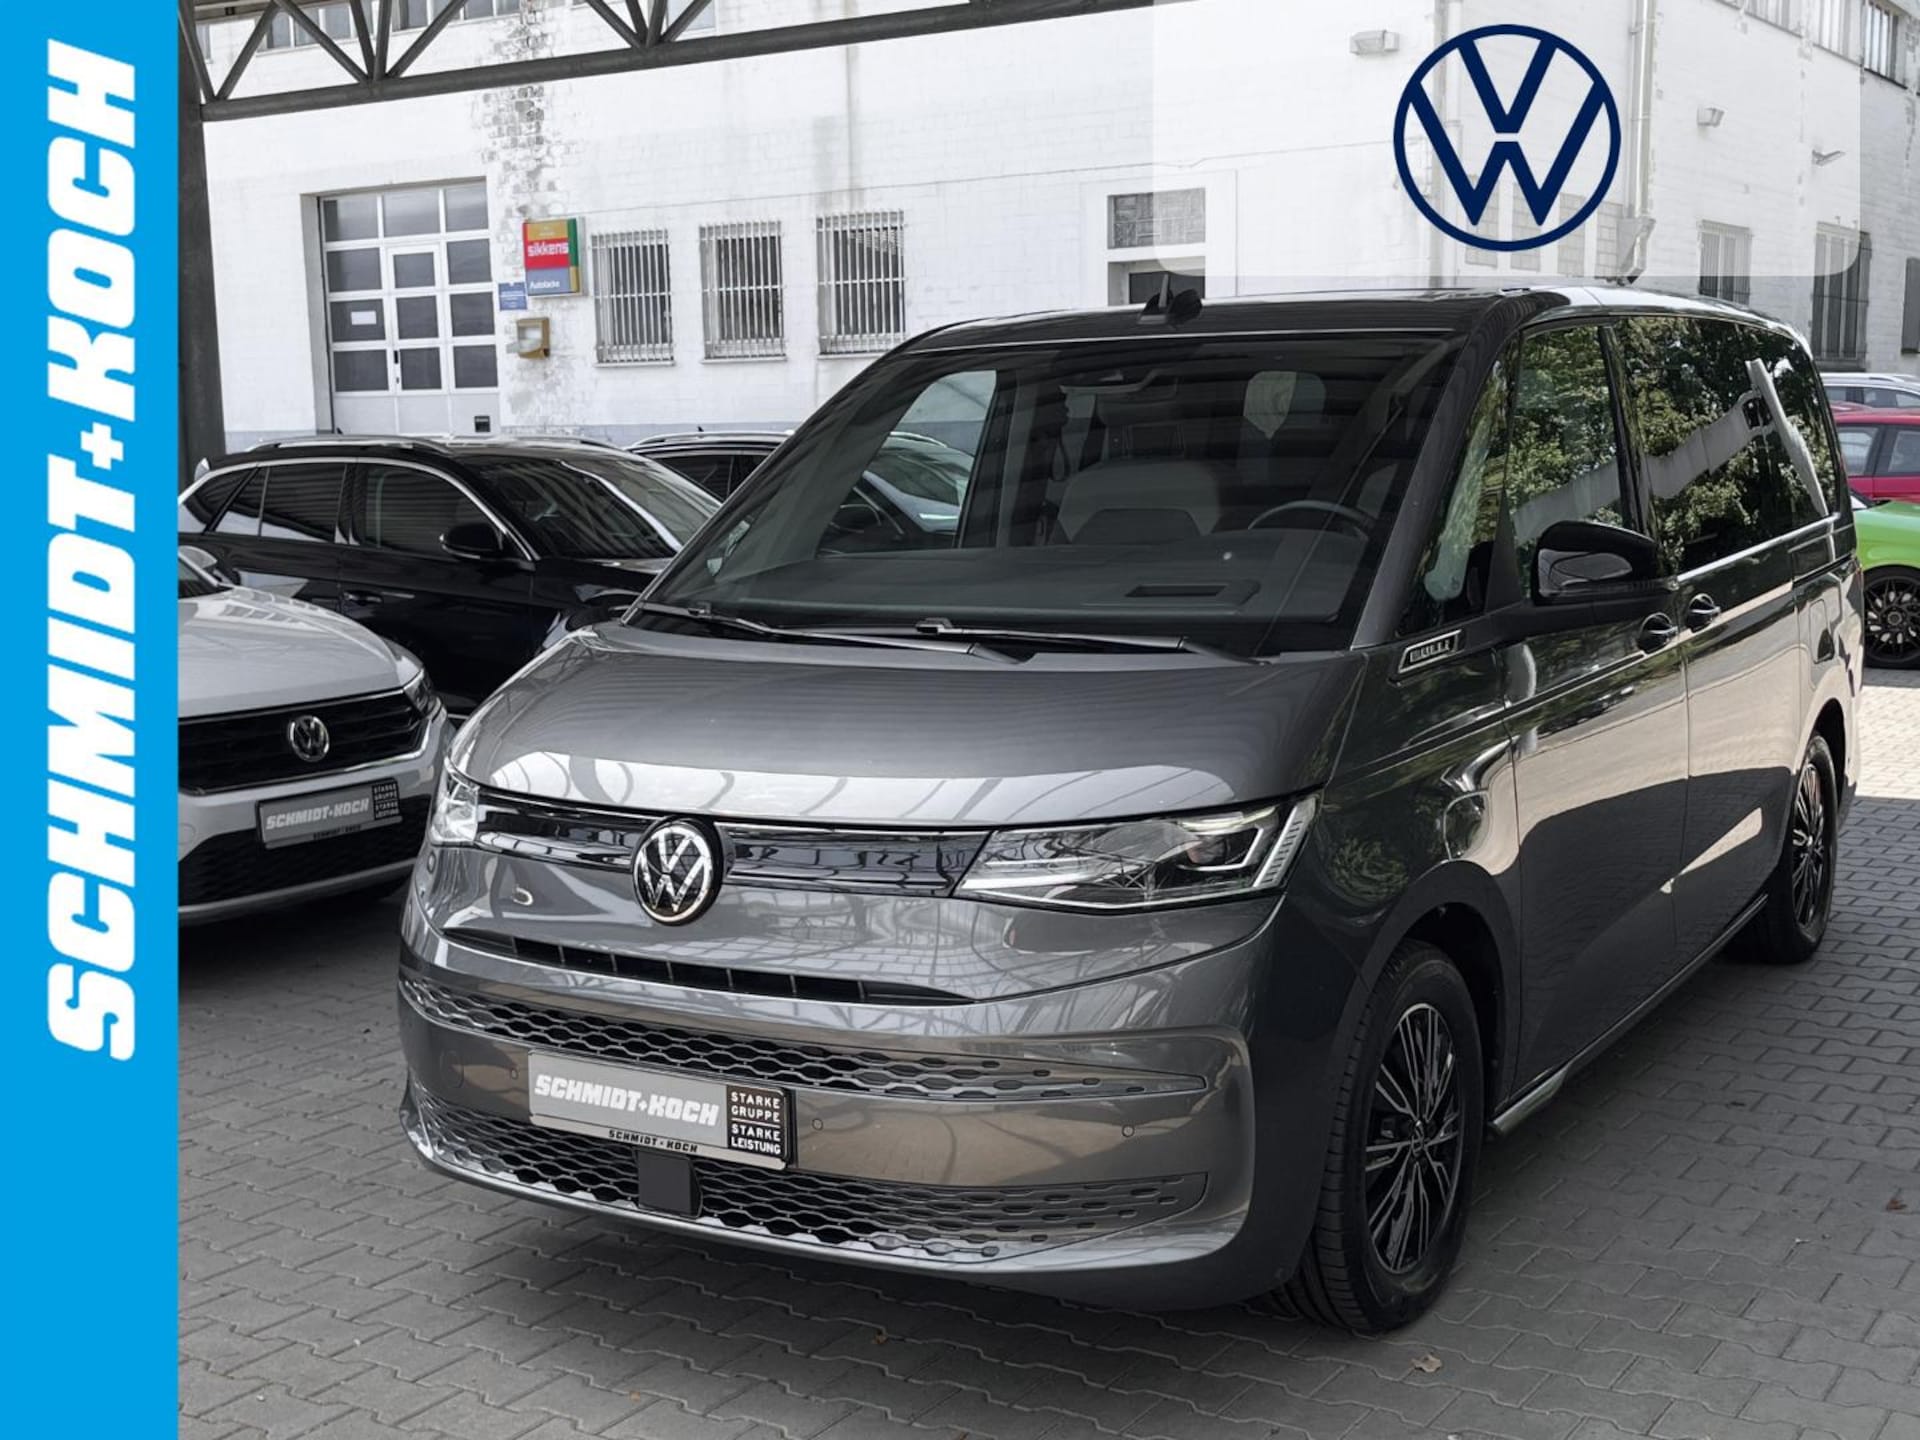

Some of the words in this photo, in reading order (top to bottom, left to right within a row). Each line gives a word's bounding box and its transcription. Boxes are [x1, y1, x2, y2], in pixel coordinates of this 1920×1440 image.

[527, 242, 569, 256] sikkens
[731, 1091, 781, 1109] STARKE
[731, 1105, 781, 1122] GRUPPE
[731, 1123, 781, 1142] STARKE
[731, 1136, 781, 1155] LEISTUNG
